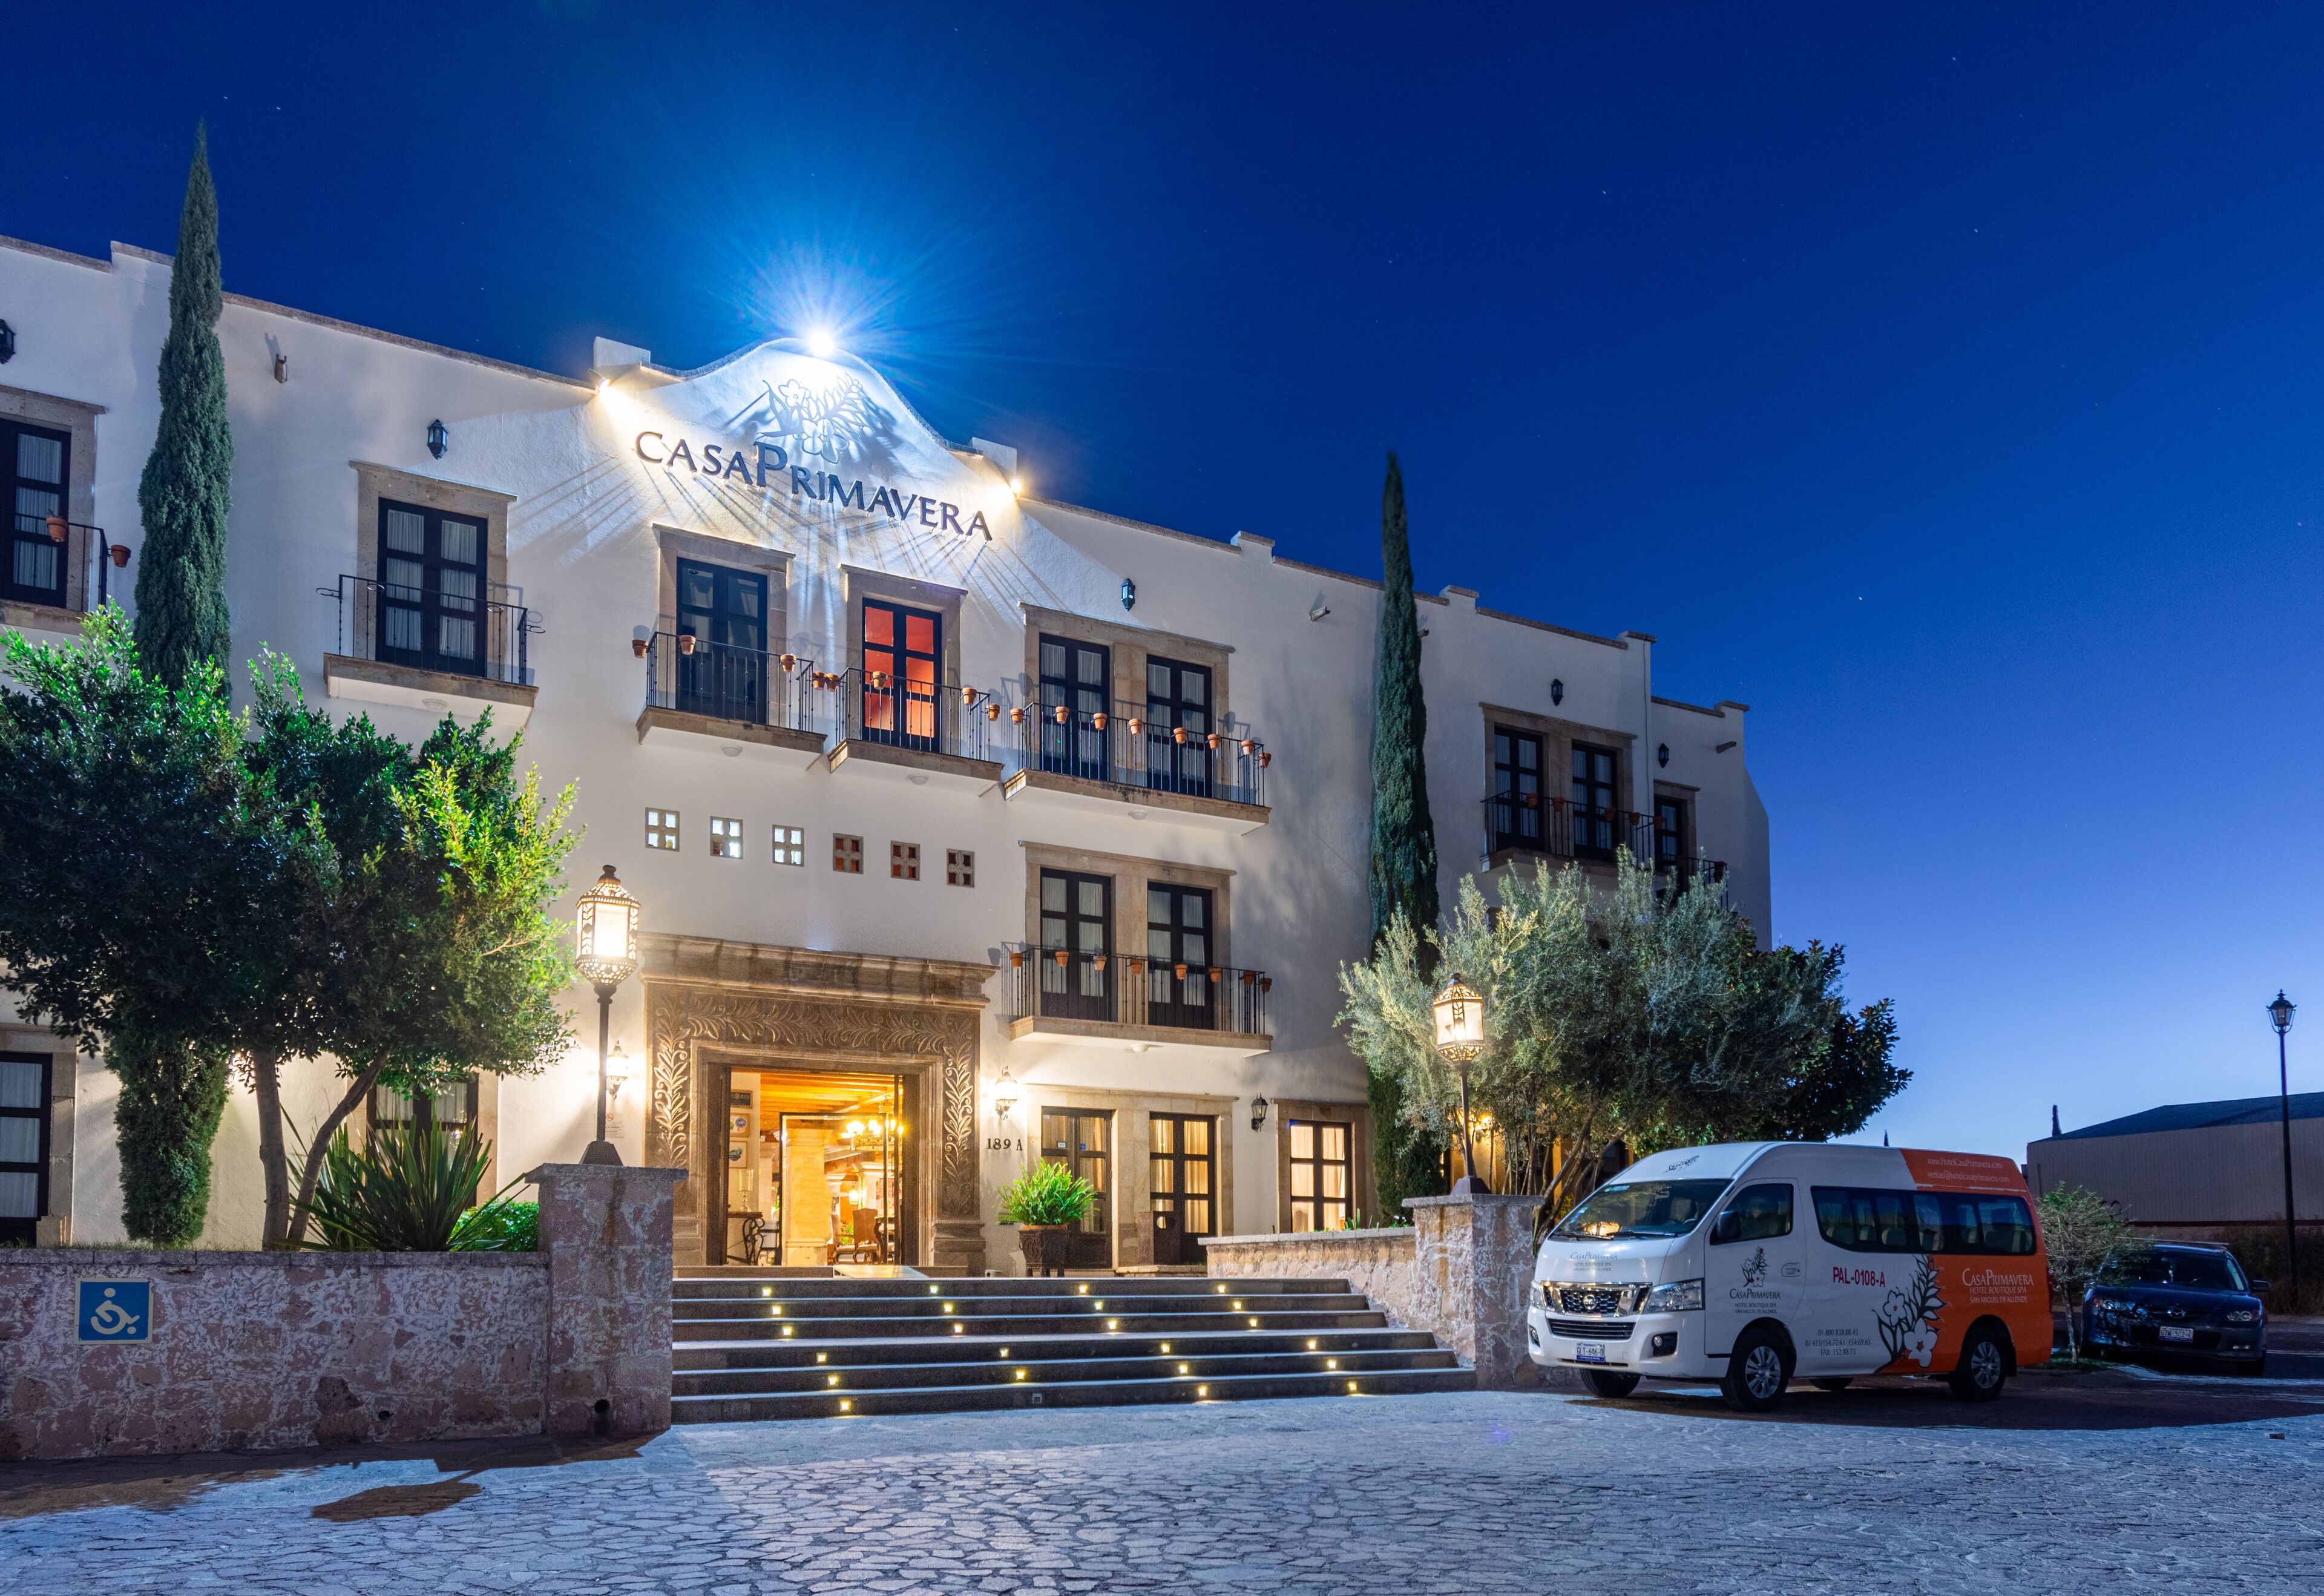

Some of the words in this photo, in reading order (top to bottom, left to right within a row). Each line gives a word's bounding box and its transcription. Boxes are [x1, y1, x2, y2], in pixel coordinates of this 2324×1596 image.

[986, 1138, 1011, 1151] 189
[1016, 1139, 1023, 1151] A
[1833, 1267, 1885, 1287] PAL-0108-A
[1989, 1286, 2016, 1295] BOUTIQUE
